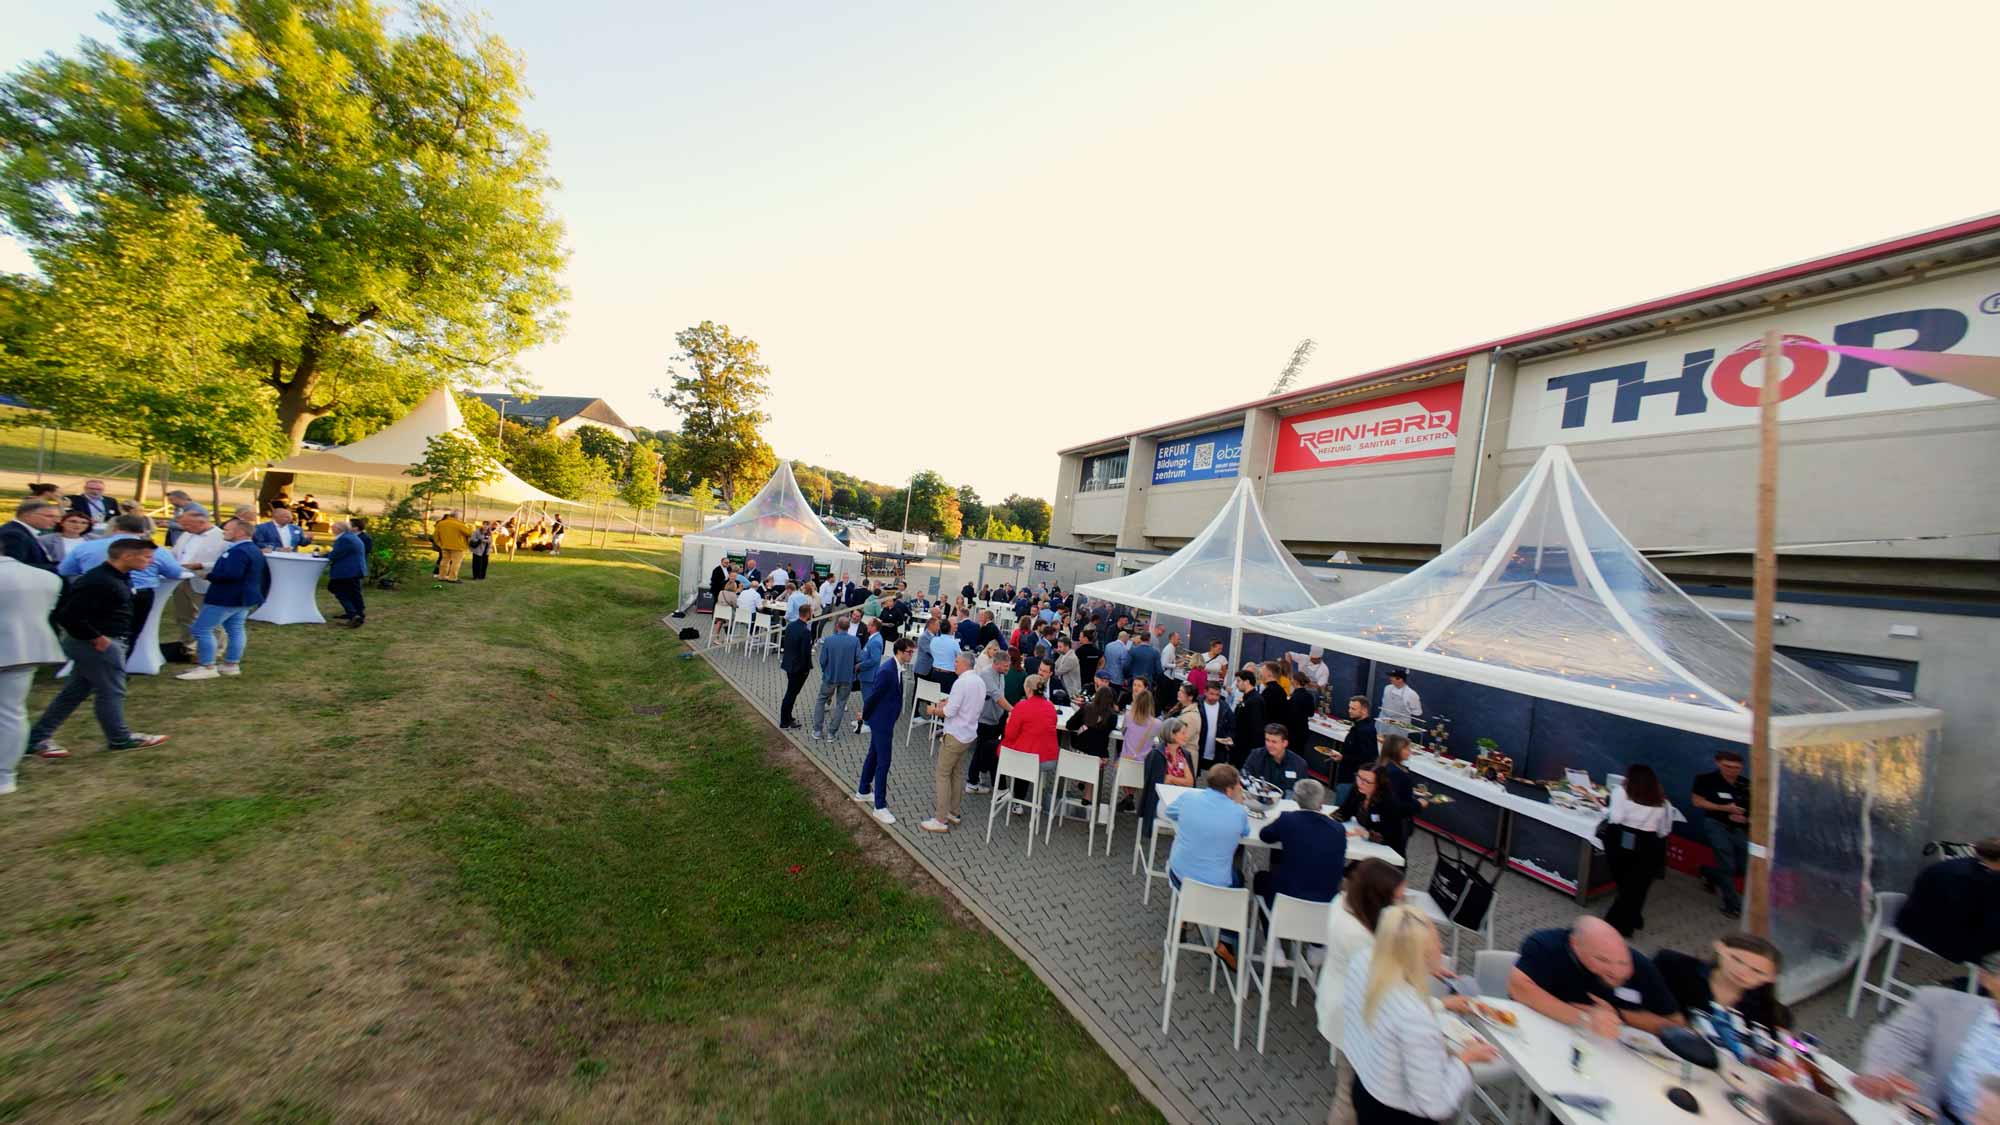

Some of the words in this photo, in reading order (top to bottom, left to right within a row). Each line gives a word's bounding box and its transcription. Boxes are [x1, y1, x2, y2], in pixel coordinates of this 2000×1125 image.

[1547, 308, 1969, 429] THOR
[1318, 445, 1351, 454] HEIZUNG
[1405, 432, 1449, 444] ELEKTRO
[1159, 444, 1190, 458] ERFURT
[1217, 444, 1240, 460] ebz
[1156, 458, 1190, 470] Bildungs-
[1155, 470, 1186, 480] zentrum
